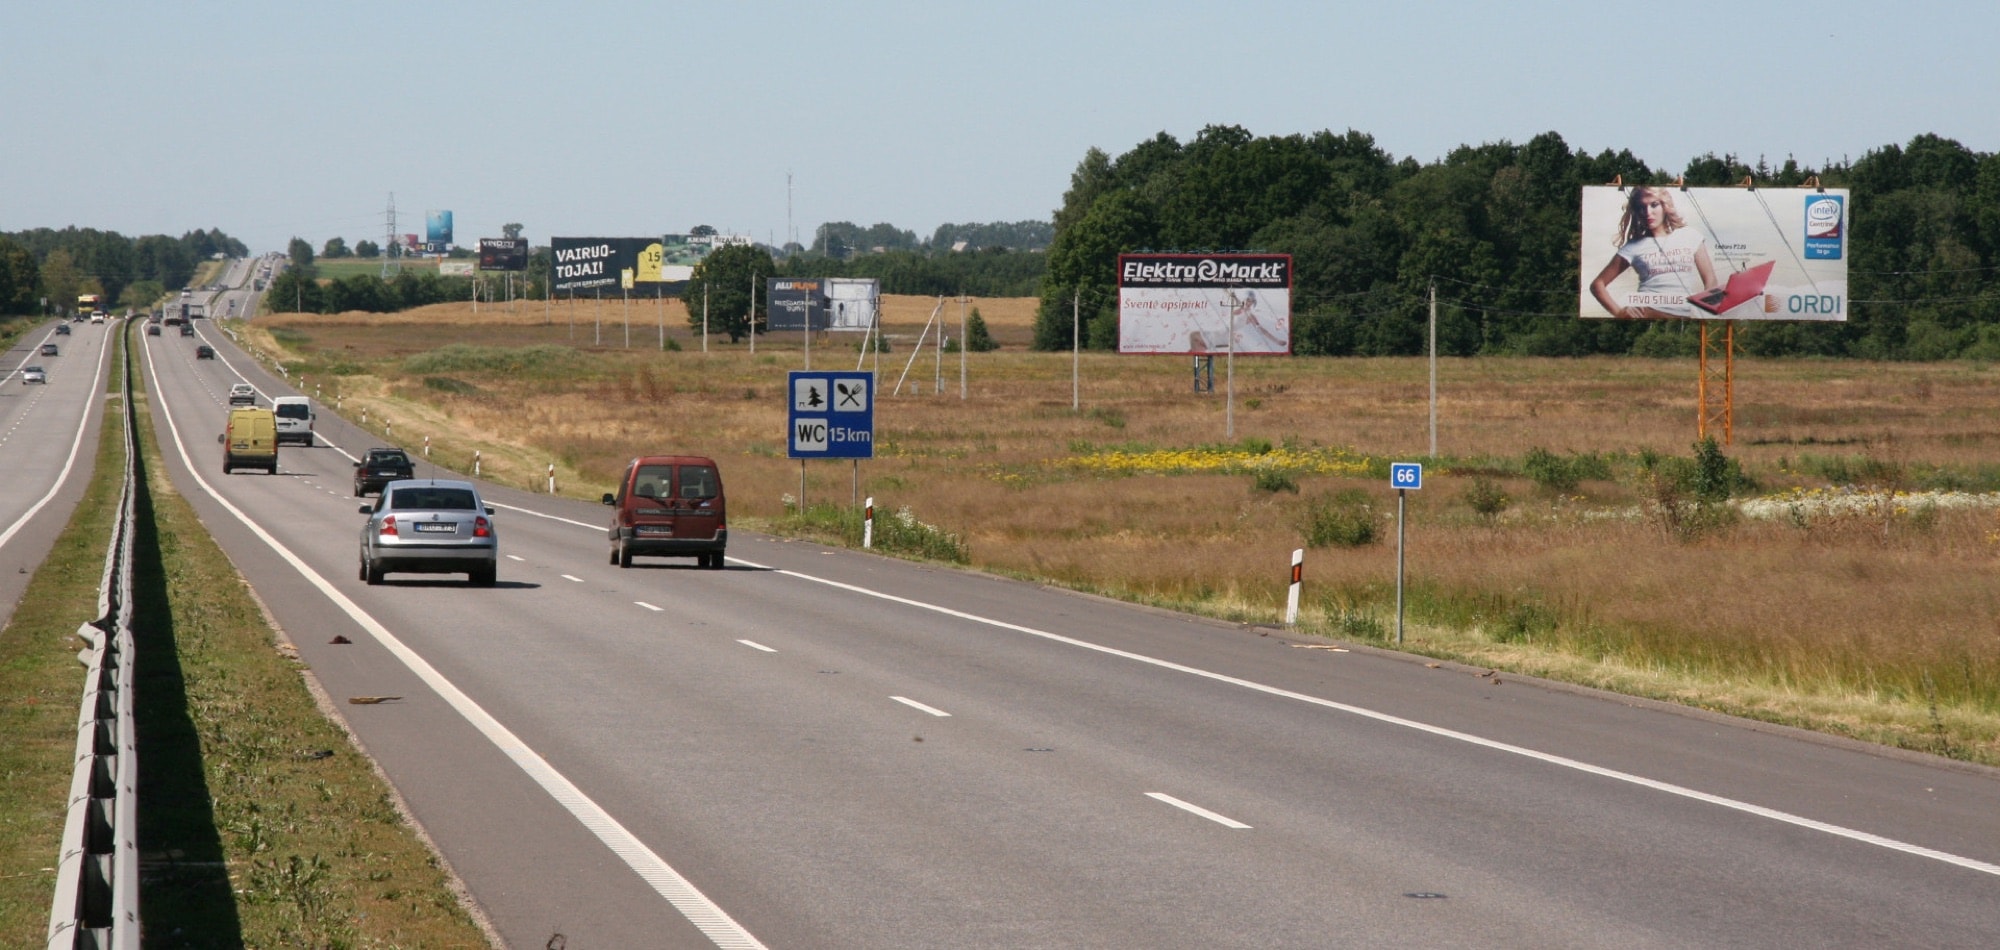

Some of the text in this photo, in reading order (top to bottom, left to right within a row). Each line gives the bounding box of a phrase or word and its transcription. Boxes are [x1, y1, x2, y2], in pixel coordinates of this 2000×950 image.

[556, 244, 616, 263] VAIRUO-
[556, 261, 603, 279] TOJAI!
[1219, 262, 1282, 278] Markt
[1628, 295, 1684, 305] TAVO STILIUS
[1788, 295, 1841, 314] ORDI
[798, 424, 870, 443] WC 15 km
[1397, 468, 1415, 483] 66
